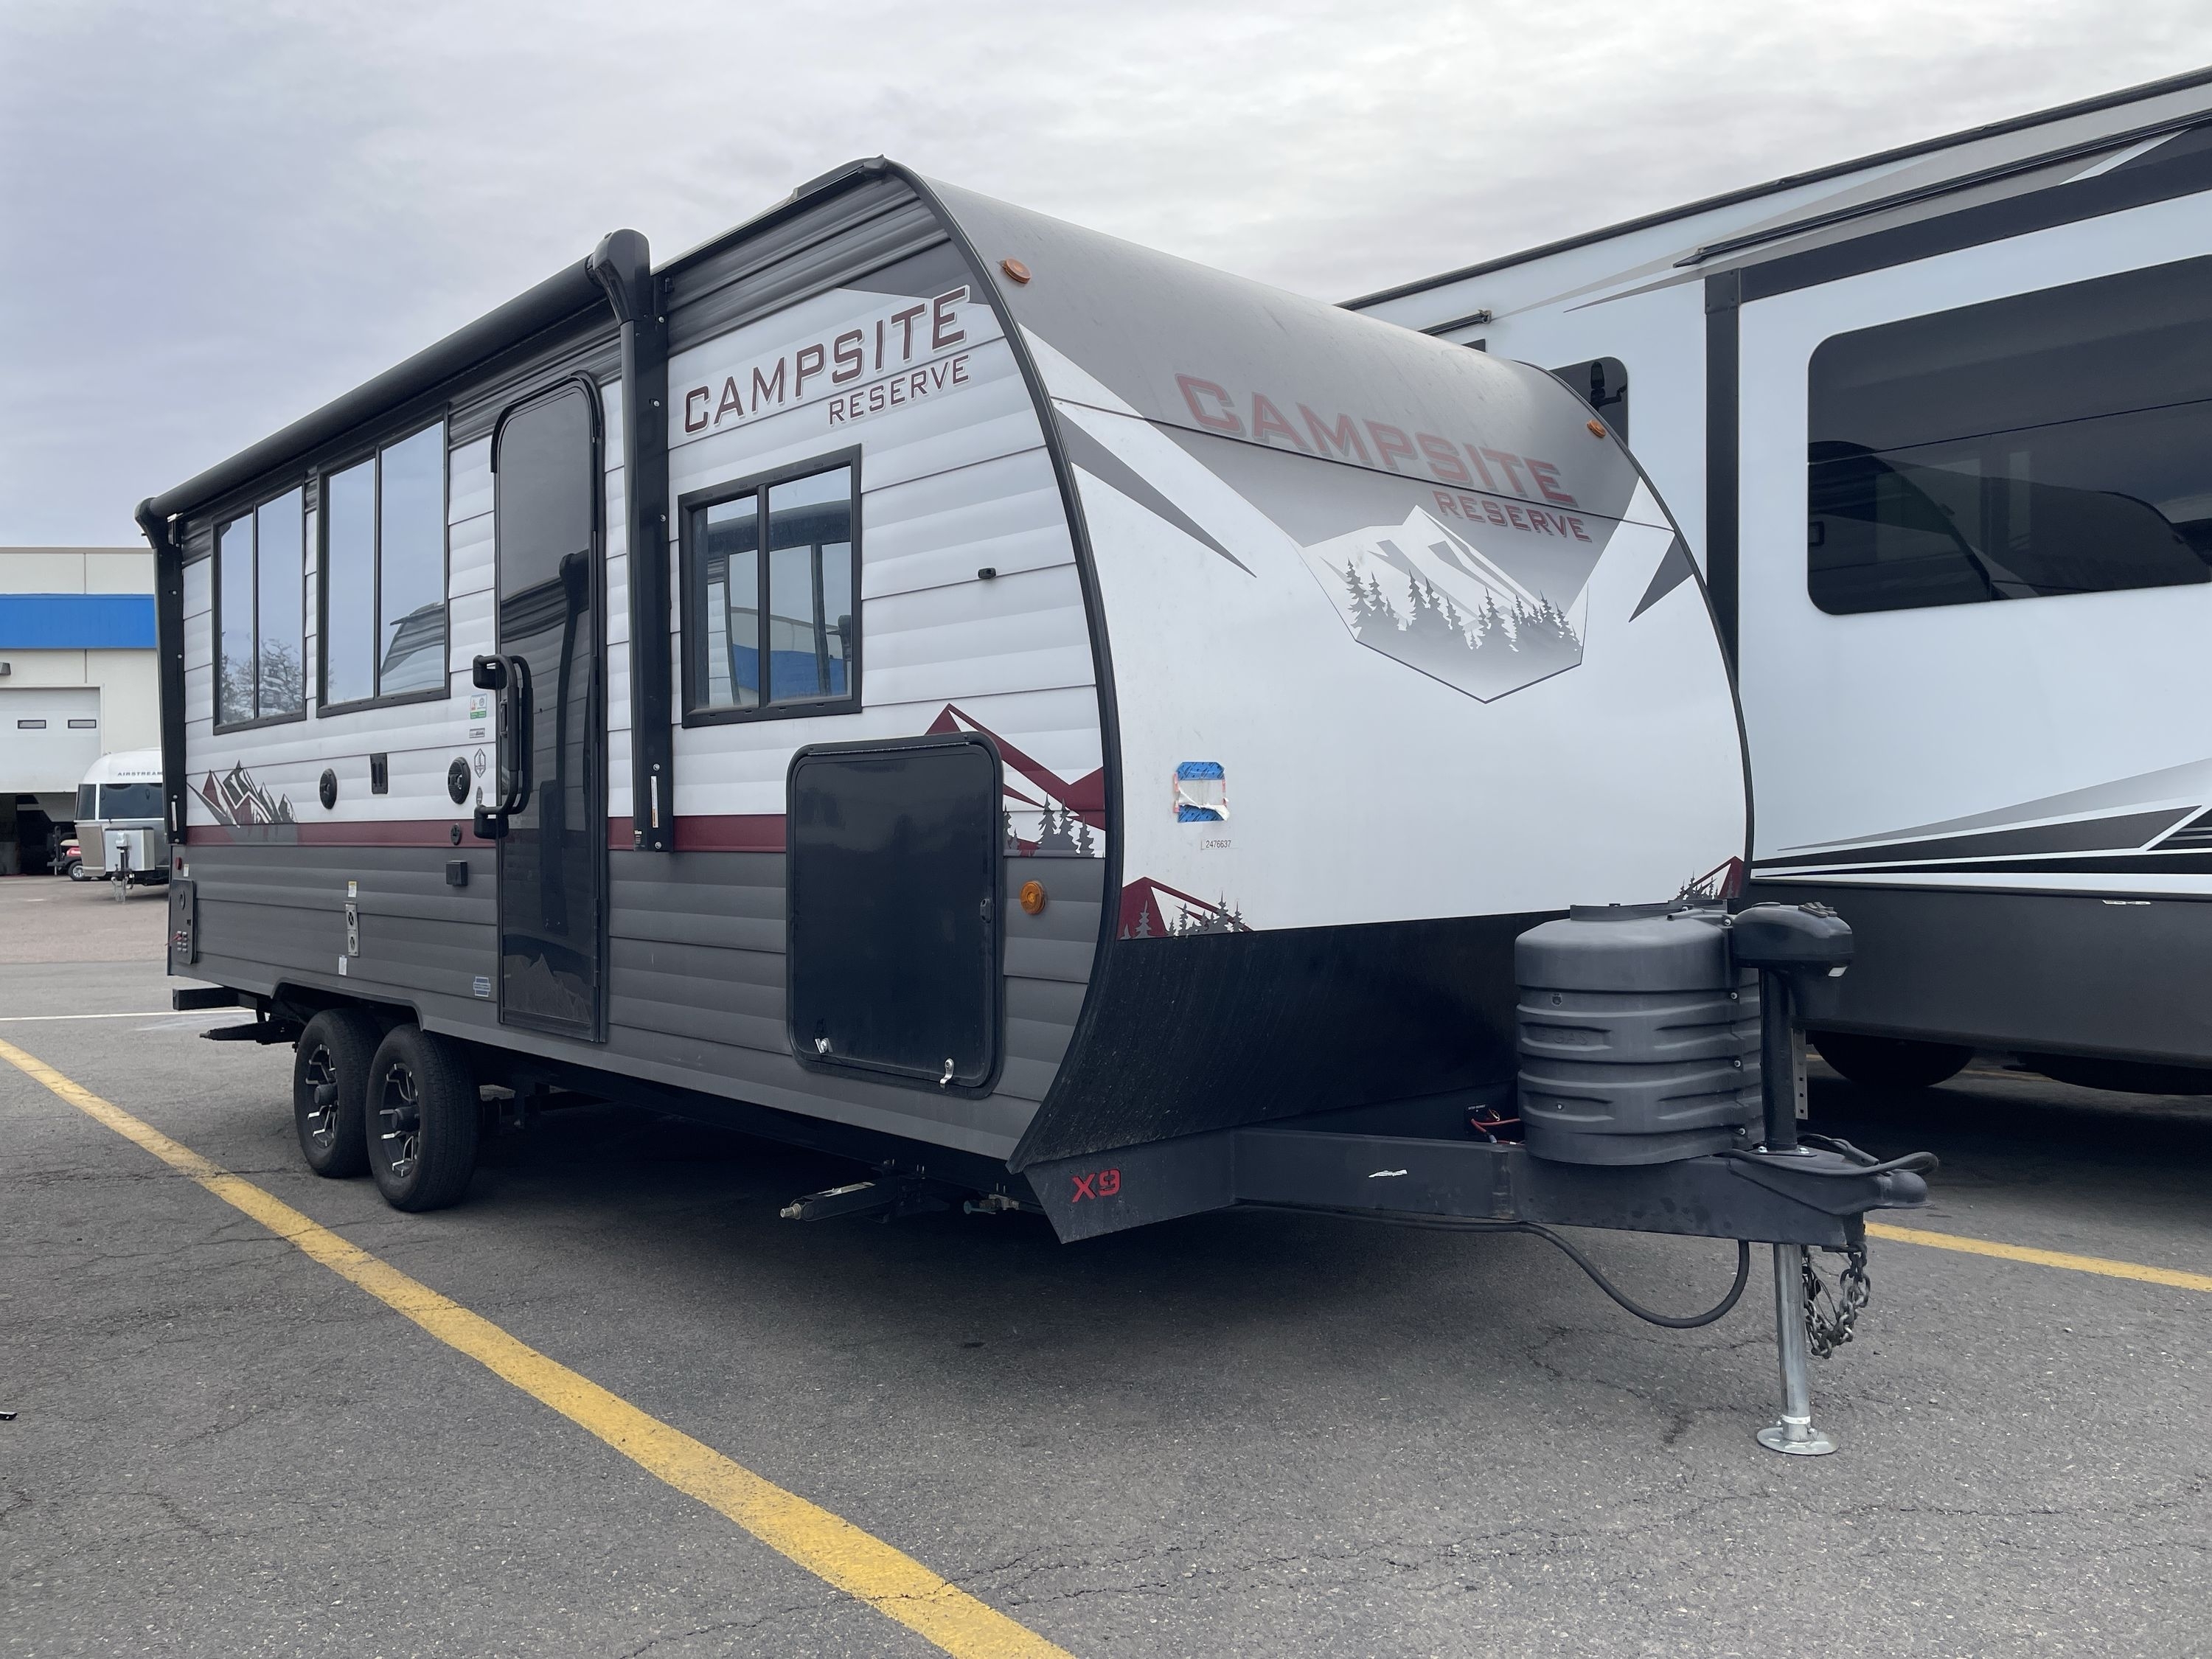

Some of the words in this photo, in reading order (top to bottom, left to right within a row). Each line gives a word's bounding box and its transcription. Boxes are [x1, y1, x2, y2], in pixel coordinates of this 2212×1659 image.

[685, 285, 971, 434] CAMPSITE
[829, 355, 970, 425] RESERVE
[1175, 373, 1577, 507] CAMPSITE
[1432, 490, 1591, 541] RESERVE
[1206, 840, 1231, 849] 2476637
[1552, 1029, 1588, 1046] GAS
[1071, 1167, 1121, 1203] X9
